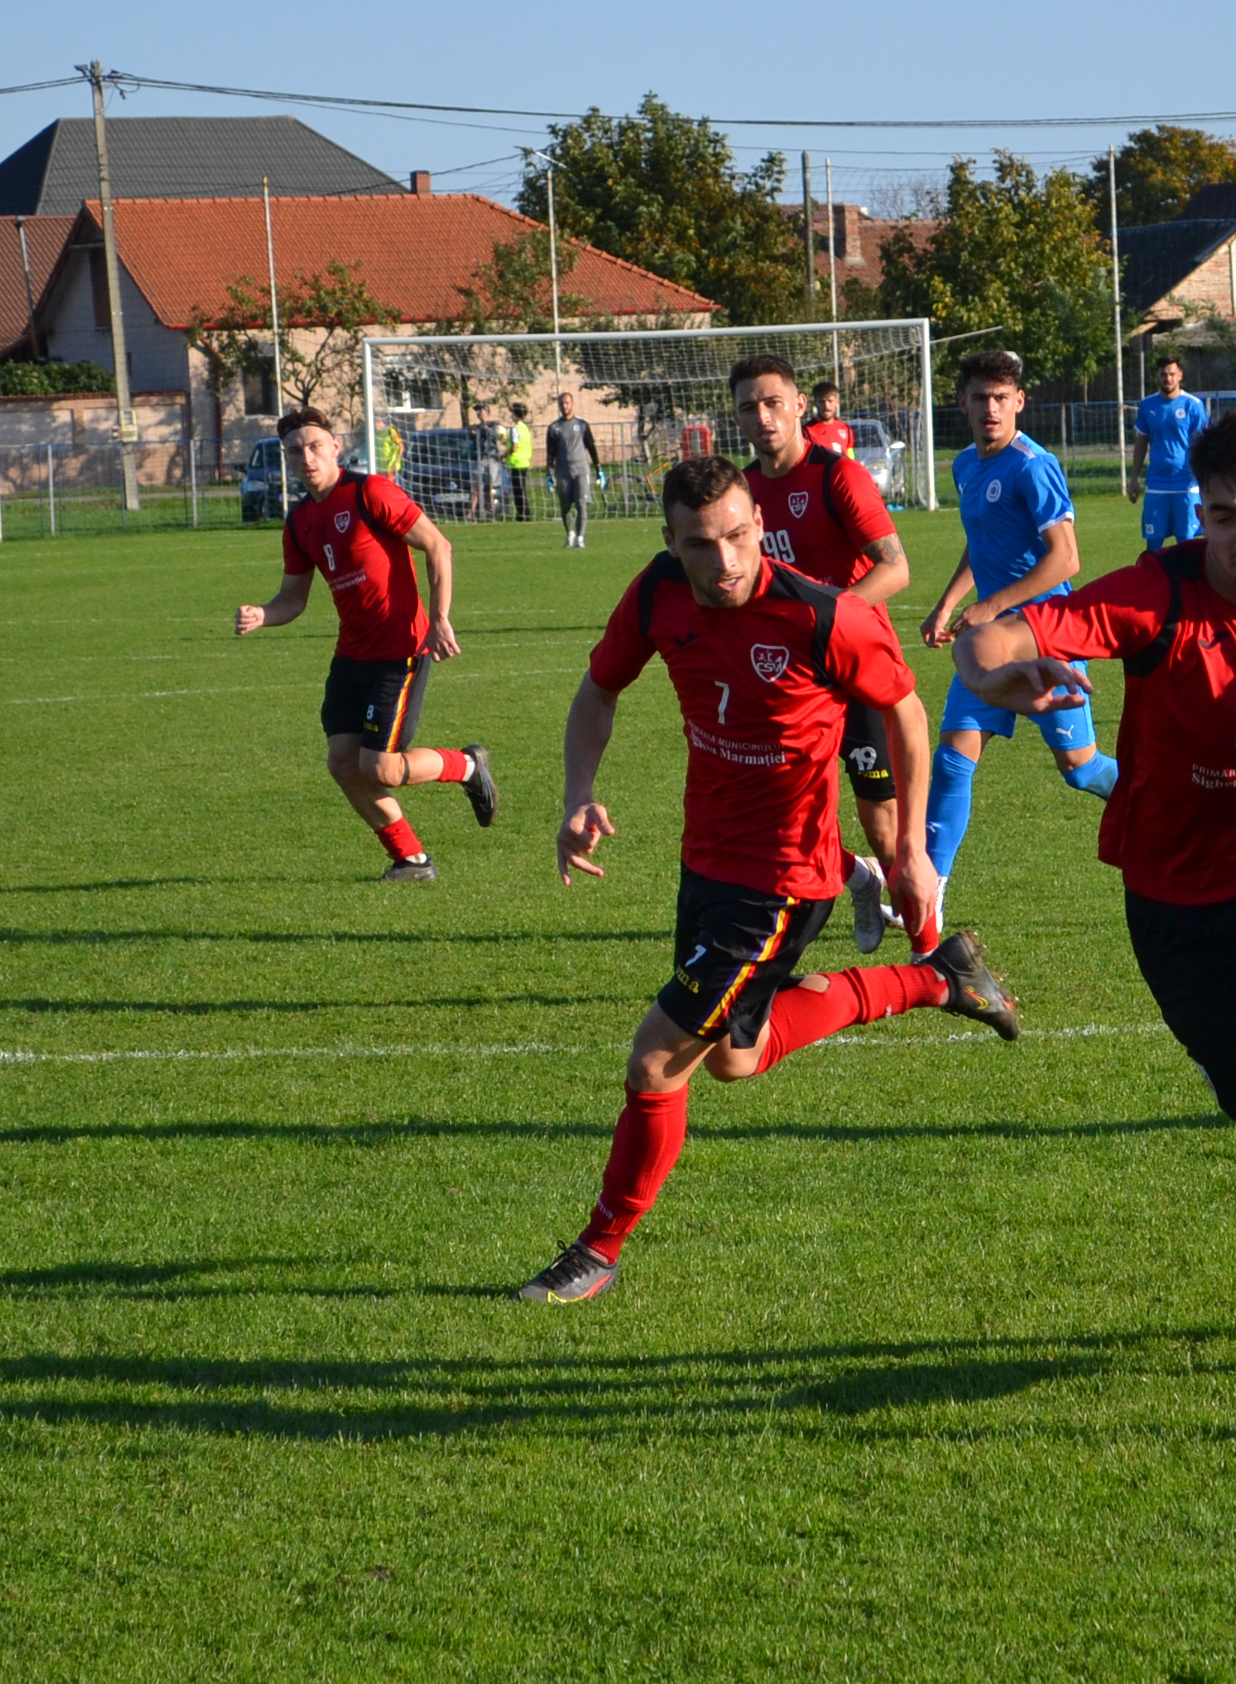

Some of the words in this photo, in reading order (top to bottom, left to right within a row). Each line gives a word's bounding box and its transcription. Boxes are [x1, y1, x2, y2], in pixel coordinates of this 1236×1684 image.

[323, 543, 336, 572] 8
[762, 529, 796, 564] 99
[366, 704, 375, 720] 8
[714, 680, 730, 725] 7
[849, 746, 877, 771] 19
[685, 944, 707, 968] 7
